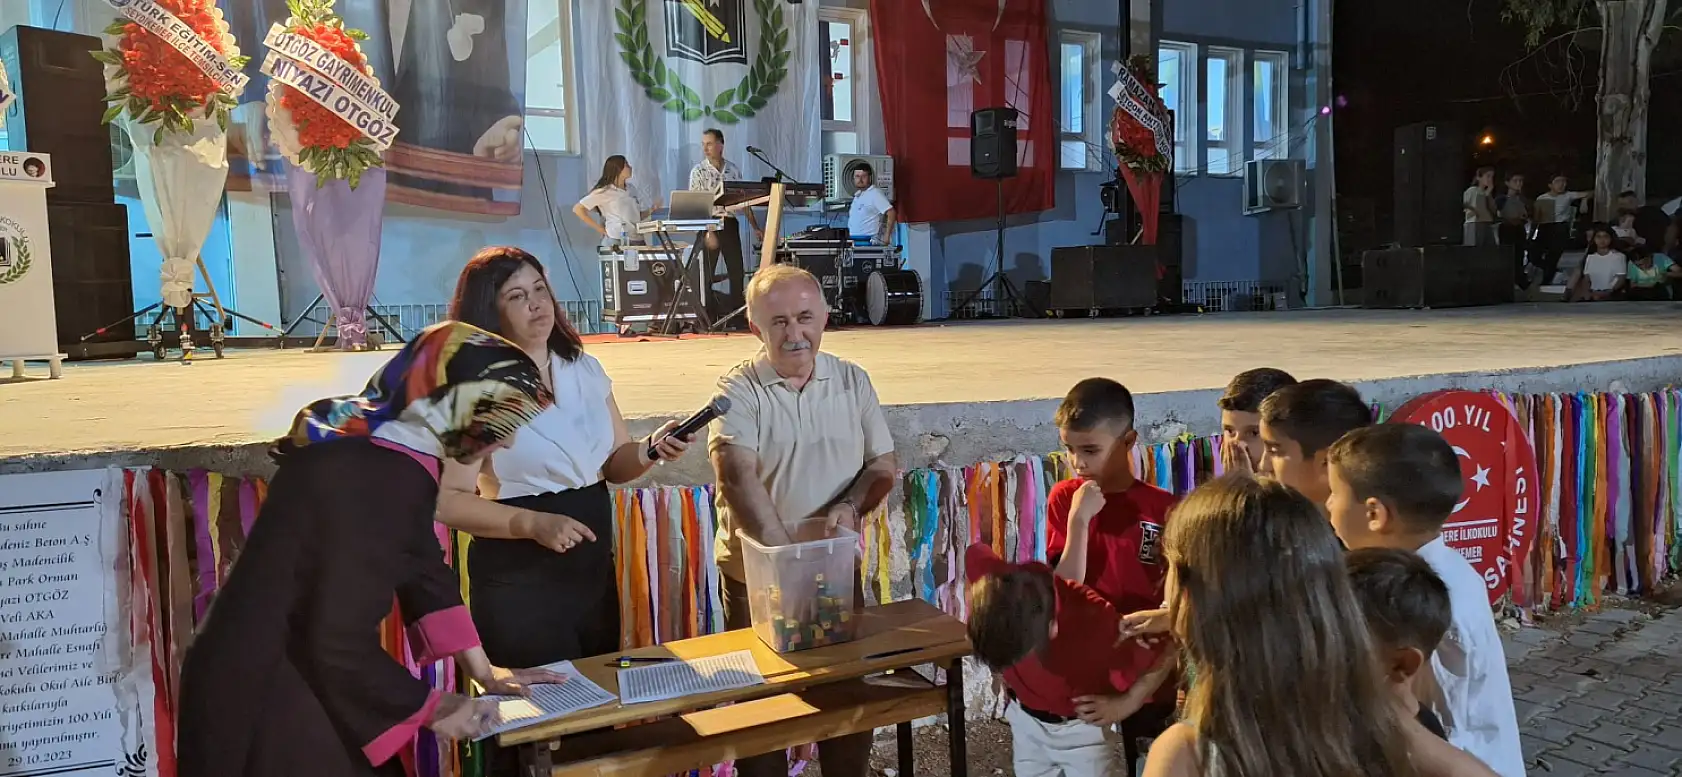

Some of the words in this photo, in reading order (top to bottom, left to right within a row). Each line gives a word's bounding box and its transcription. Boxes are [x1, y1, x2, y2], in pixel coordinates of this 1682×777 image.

[274, 33, 319, 62] OTGÖZ
[316, 53, 395, 119] GAYRİMENKUL
[270, 57, 335, 102] NİYAZİ
[334, 95, 395, 145] OTGÖZ
[1421, 404, 1491, 433] 00.YIL
[14, 519, 47, 531] sahne
[1460, 525, 1498, 541] İLKOKULU
[35, 536, 66, 548] Beton
[12, 552, 75, 568] Madencilik
[8, 573, 34, 587] Park
[38, 573, 78, 584] Orman
[25, 588, 69, 604] OTGÖZ
[0, 611, 21, 623] Veli
[26, 609, 54, 621] AKA
[0, 627, 47, 641] Mahalle
[16, 644, 61, 658] Mahalle
[18, 662, 78, 676] Velilerimiz
[82, 661, 94, 669] ve
[40, 679, 67, 692] Okul
[71, 676, 92, 689] Aile
[2, 696, 68, 713] katkılarıyla
[0, 717, 63, 735] riyetimizin
[8, 750, 72, 767] 29.10.2023
